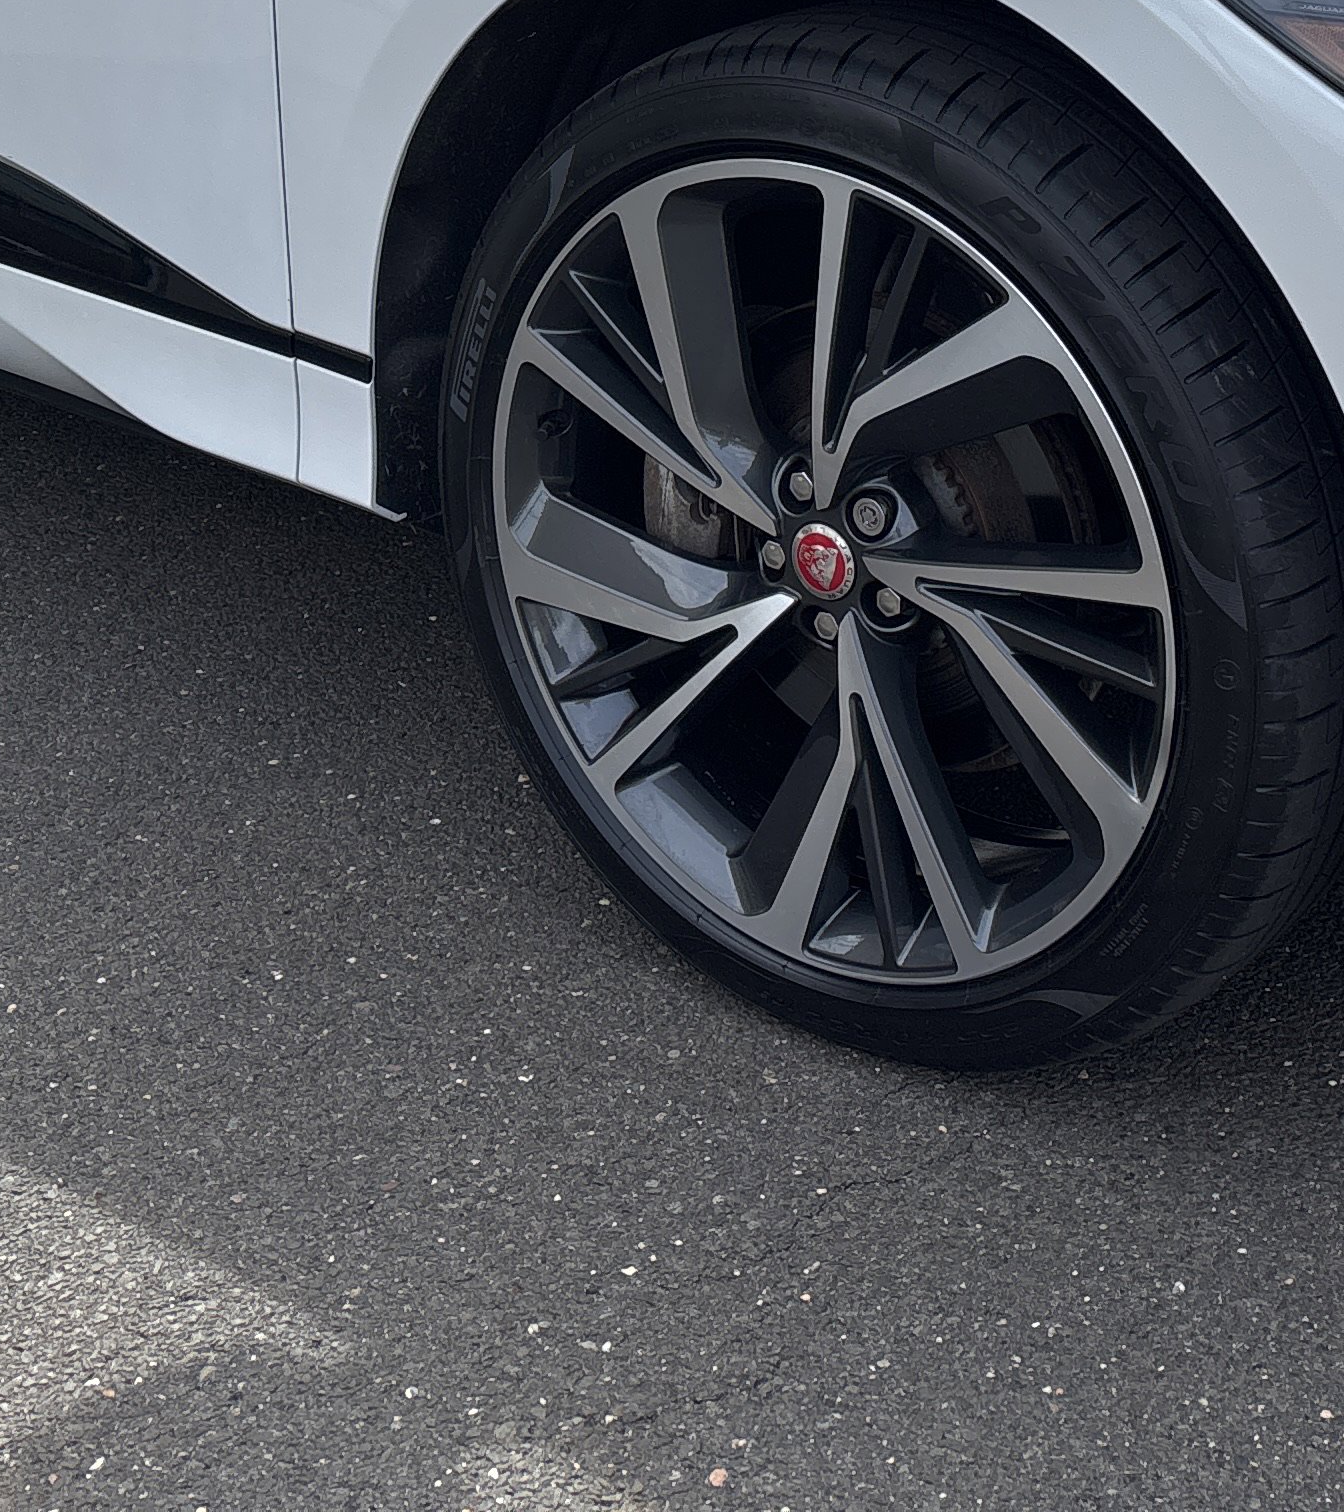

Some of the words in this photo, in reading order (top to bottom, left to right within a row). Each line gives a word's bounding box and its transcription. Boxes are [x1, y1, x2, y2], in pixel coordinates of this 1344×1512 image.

[450, 278, 497, 423] PIRELLI
[978, 195, 1042, 235] P
[1039, 256, 1214, 507] ZERO
